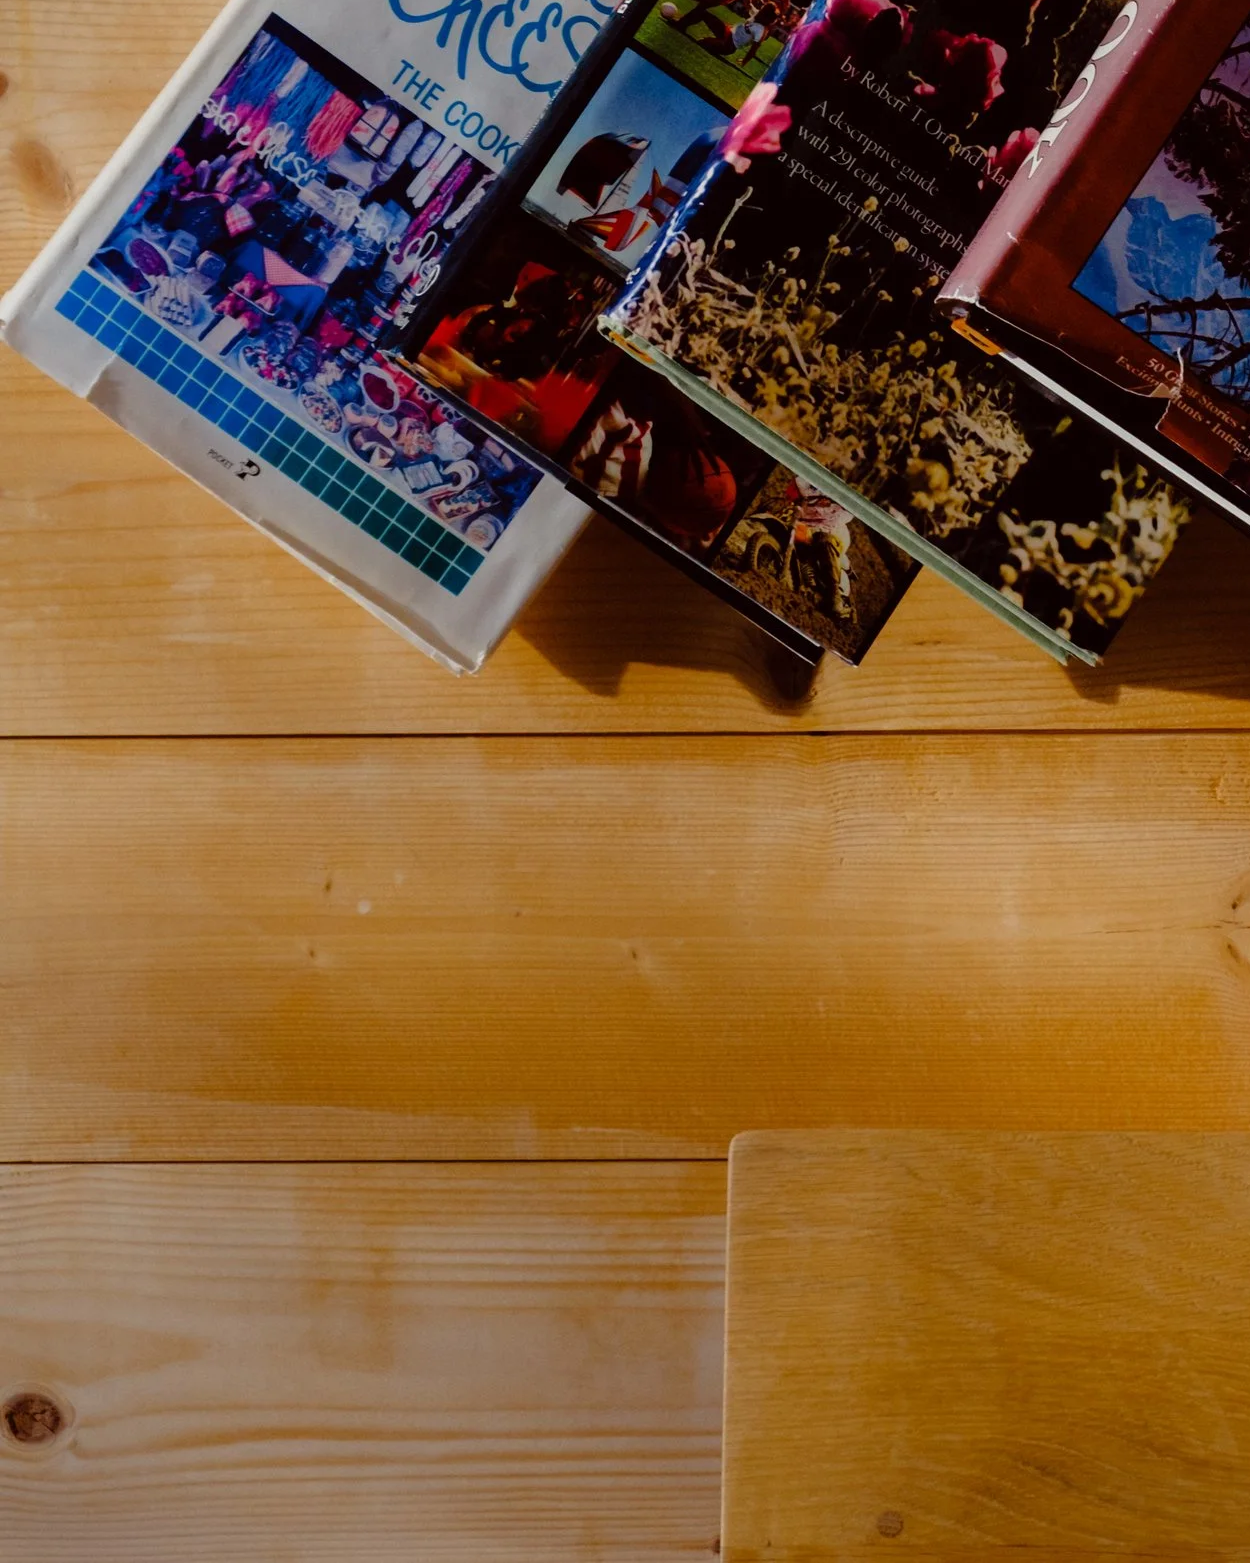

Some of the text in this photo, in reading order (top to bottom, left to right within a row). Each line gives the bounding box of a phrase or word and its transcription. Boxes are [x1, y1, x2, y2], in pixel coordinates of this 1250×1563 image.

[391, 59, 523, 165] THE COOK
[811, 100, 940, 198] A descriptive guide
[839, 55, 861, 81] by
[860, 69, 908, 113] Robert
[910, 105, 928, 126] T.
[924, 118, 956, 146] Orr
[777, 151, 789, 164] a
[786, 157, 839, 196] special
[833, 191, 918, 259] identificatn
[798, 124, 968, 256] with 291 color photographs
[1114, 354, 1162, 387] Excitin
[1145, 357, 1167, 374] 50
[1198, 393, 1238, 429] Stories
